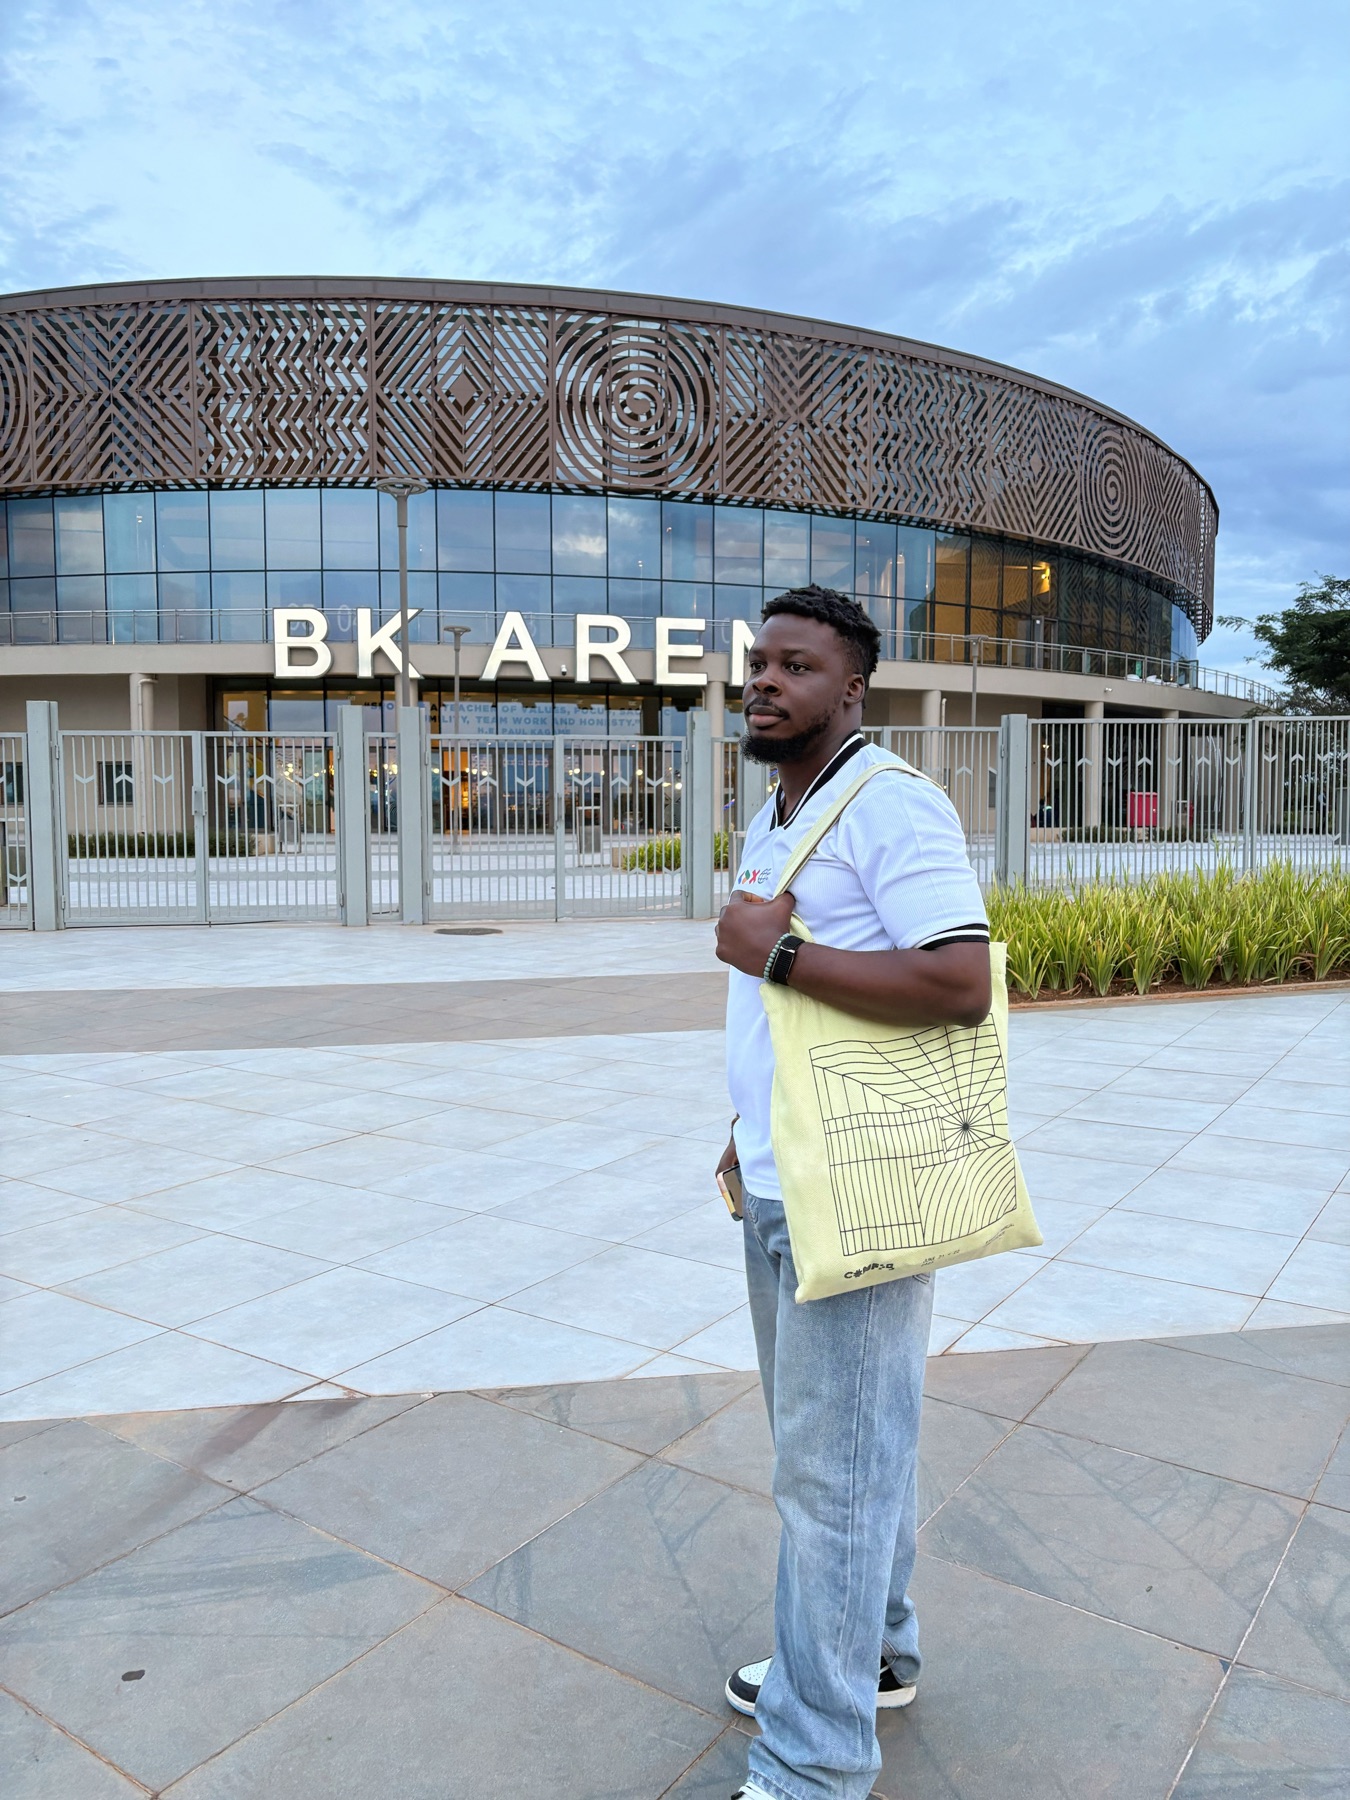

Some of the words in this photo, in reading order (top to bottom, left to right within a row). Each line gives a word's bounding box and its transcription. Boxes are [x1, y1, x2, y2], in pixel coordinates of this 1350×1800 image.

[273, 607, 424, 679] BK
[501, 705, 517, 713] OF
[512, 716, 548, 725] WORK
